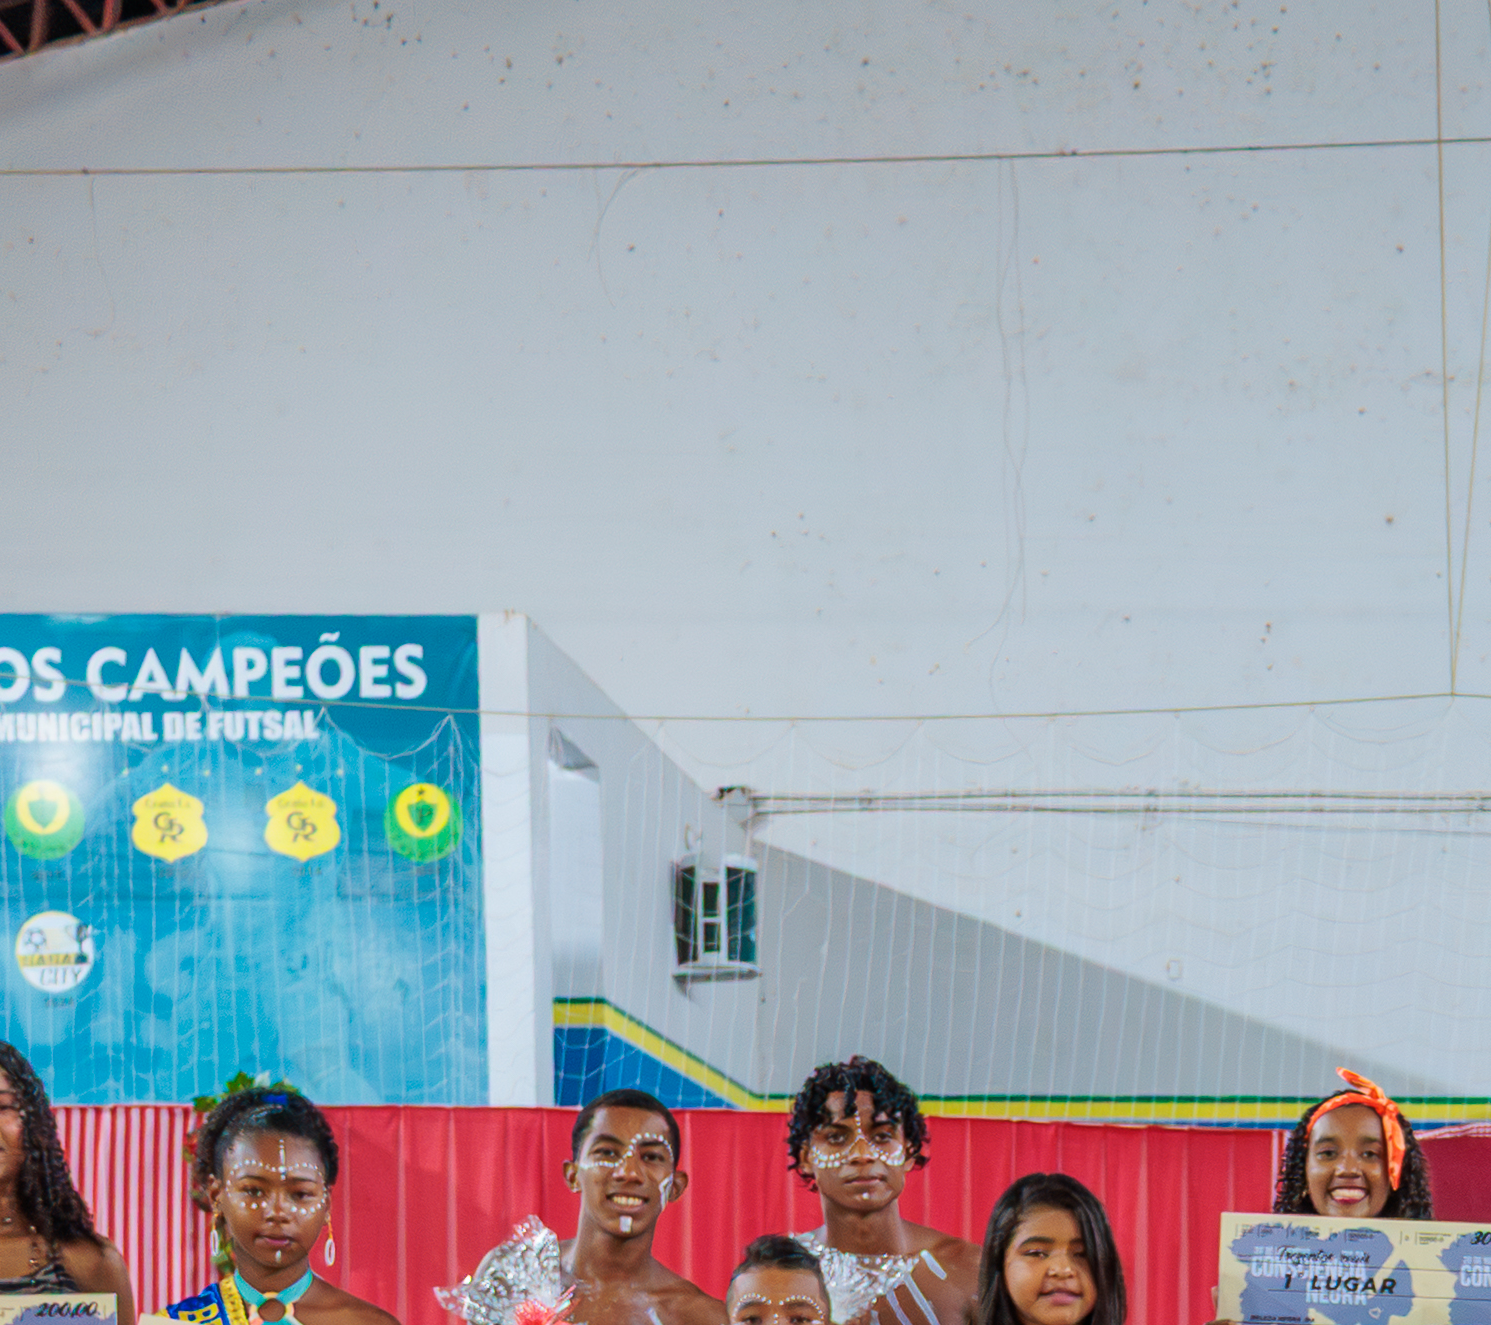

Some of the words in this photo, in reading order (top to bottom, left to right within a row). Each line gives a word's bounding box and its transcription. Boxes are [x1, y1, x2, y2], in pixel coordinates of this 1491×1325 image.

[86, 632, 428, 702] CAMPEÕES
[163, 711, 204, 741] DE
[209, 710, 320, 741] FUTSAL
[1310, 1274, 1398, 1295] LUGAR
